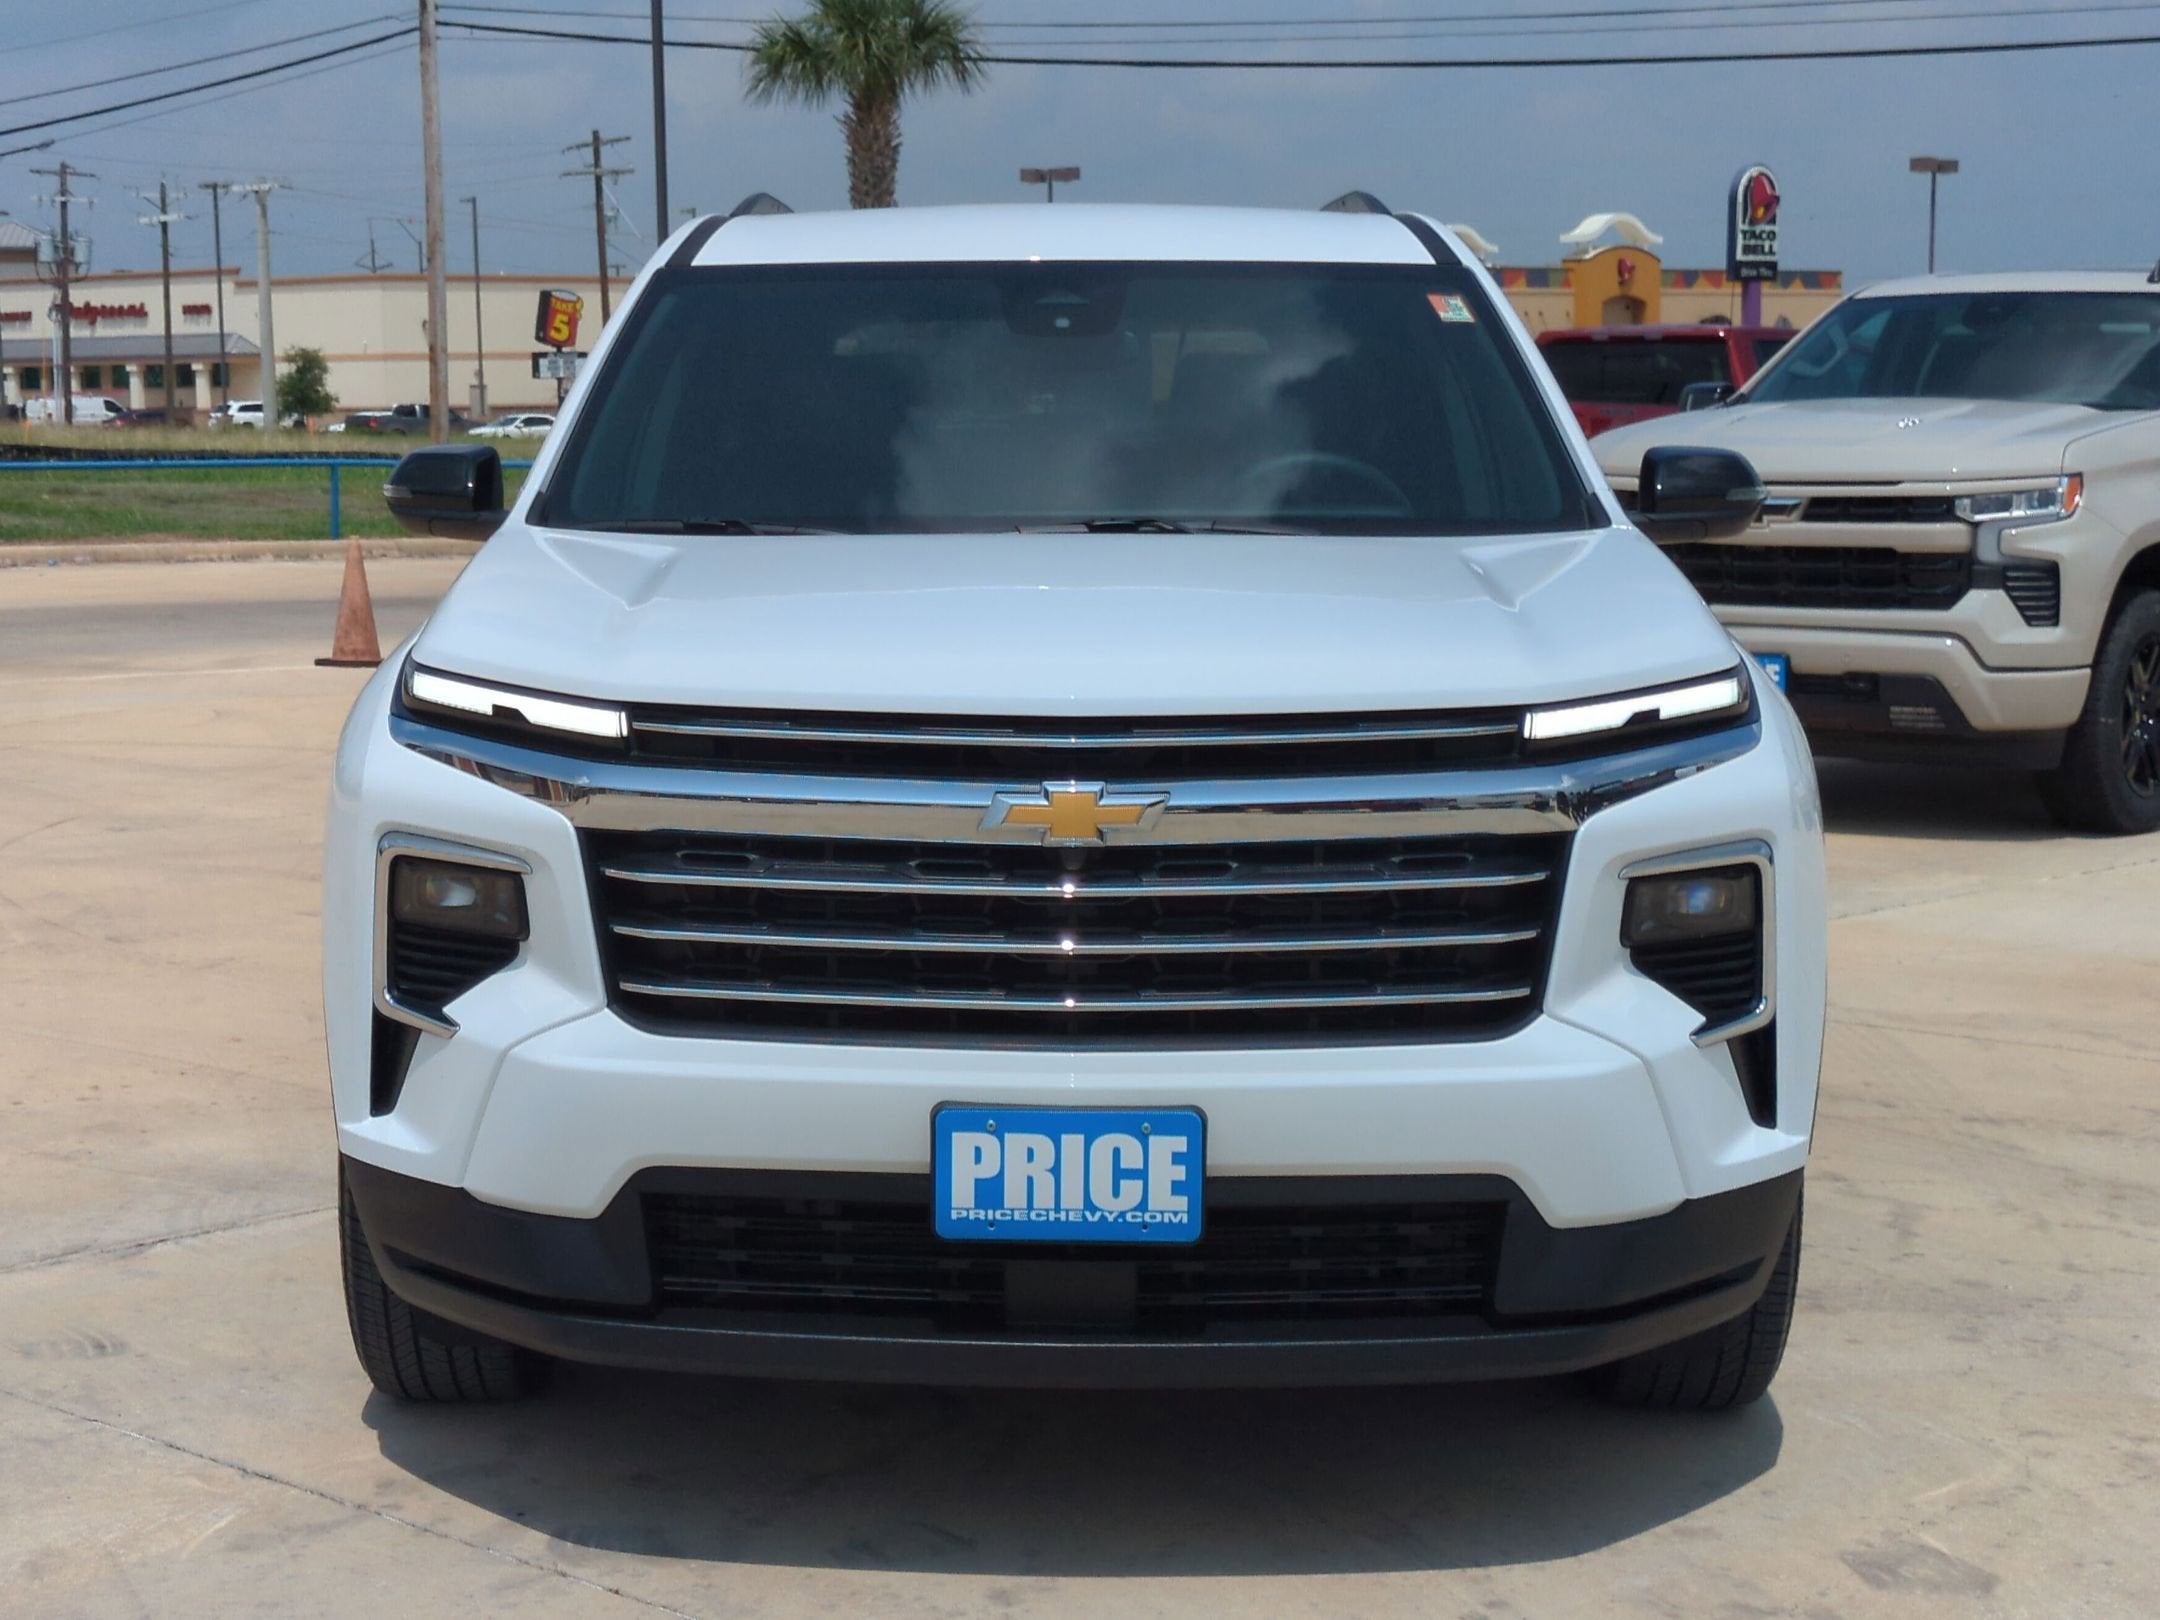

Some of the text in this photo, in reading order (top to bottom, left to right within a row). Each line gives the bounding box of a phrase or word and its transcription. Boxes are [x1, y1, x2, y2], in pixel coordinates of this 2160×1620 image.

[1741, 229, 1776, 241] TACO
[1742, 243, 1776, 256] BELL
[549, 313, 570, 342] 5
[951, 1132, 1188, 1212] PRICE
[951, 1209, 1188, 1224] PRICECHEVY.COM
